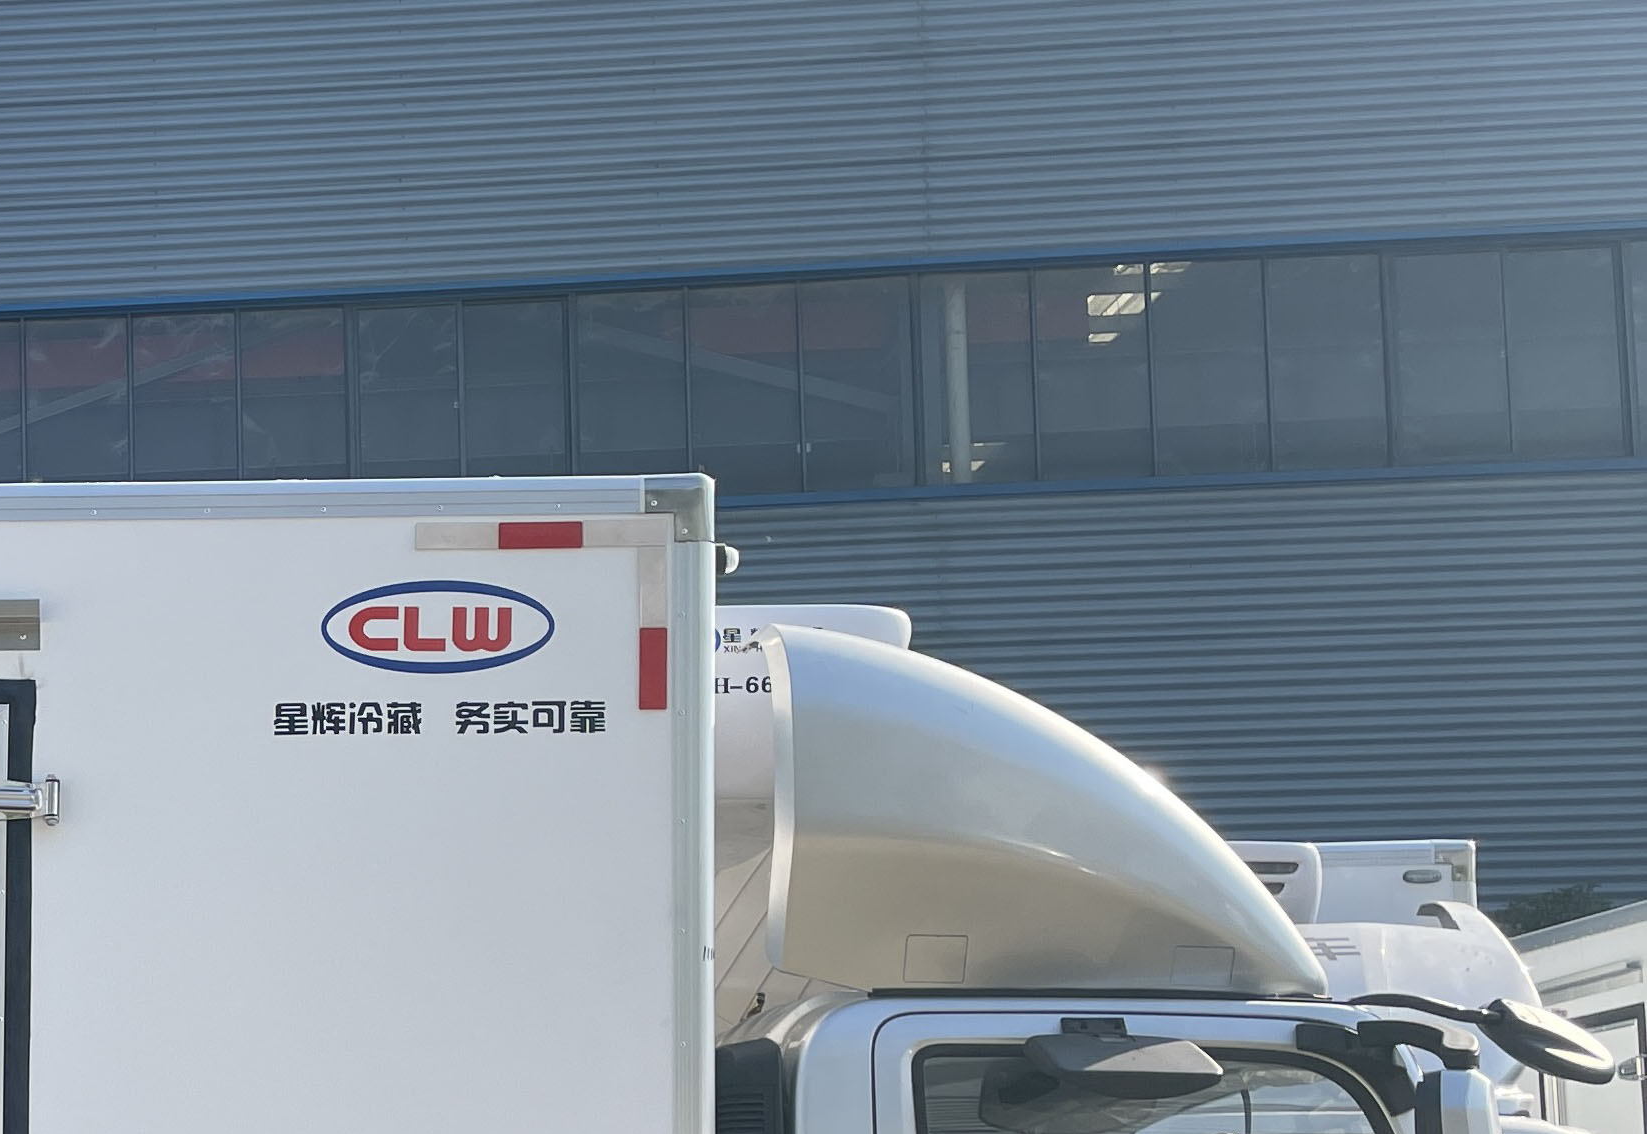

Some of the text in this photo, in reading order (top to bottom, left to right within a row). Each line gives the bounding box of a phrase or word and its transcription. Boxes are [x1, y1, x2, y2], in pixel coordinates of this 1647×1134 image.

[348, 606, 512, 652] CLW
[274, 700, 607, 735] 星辉冷藏 务实可靠
